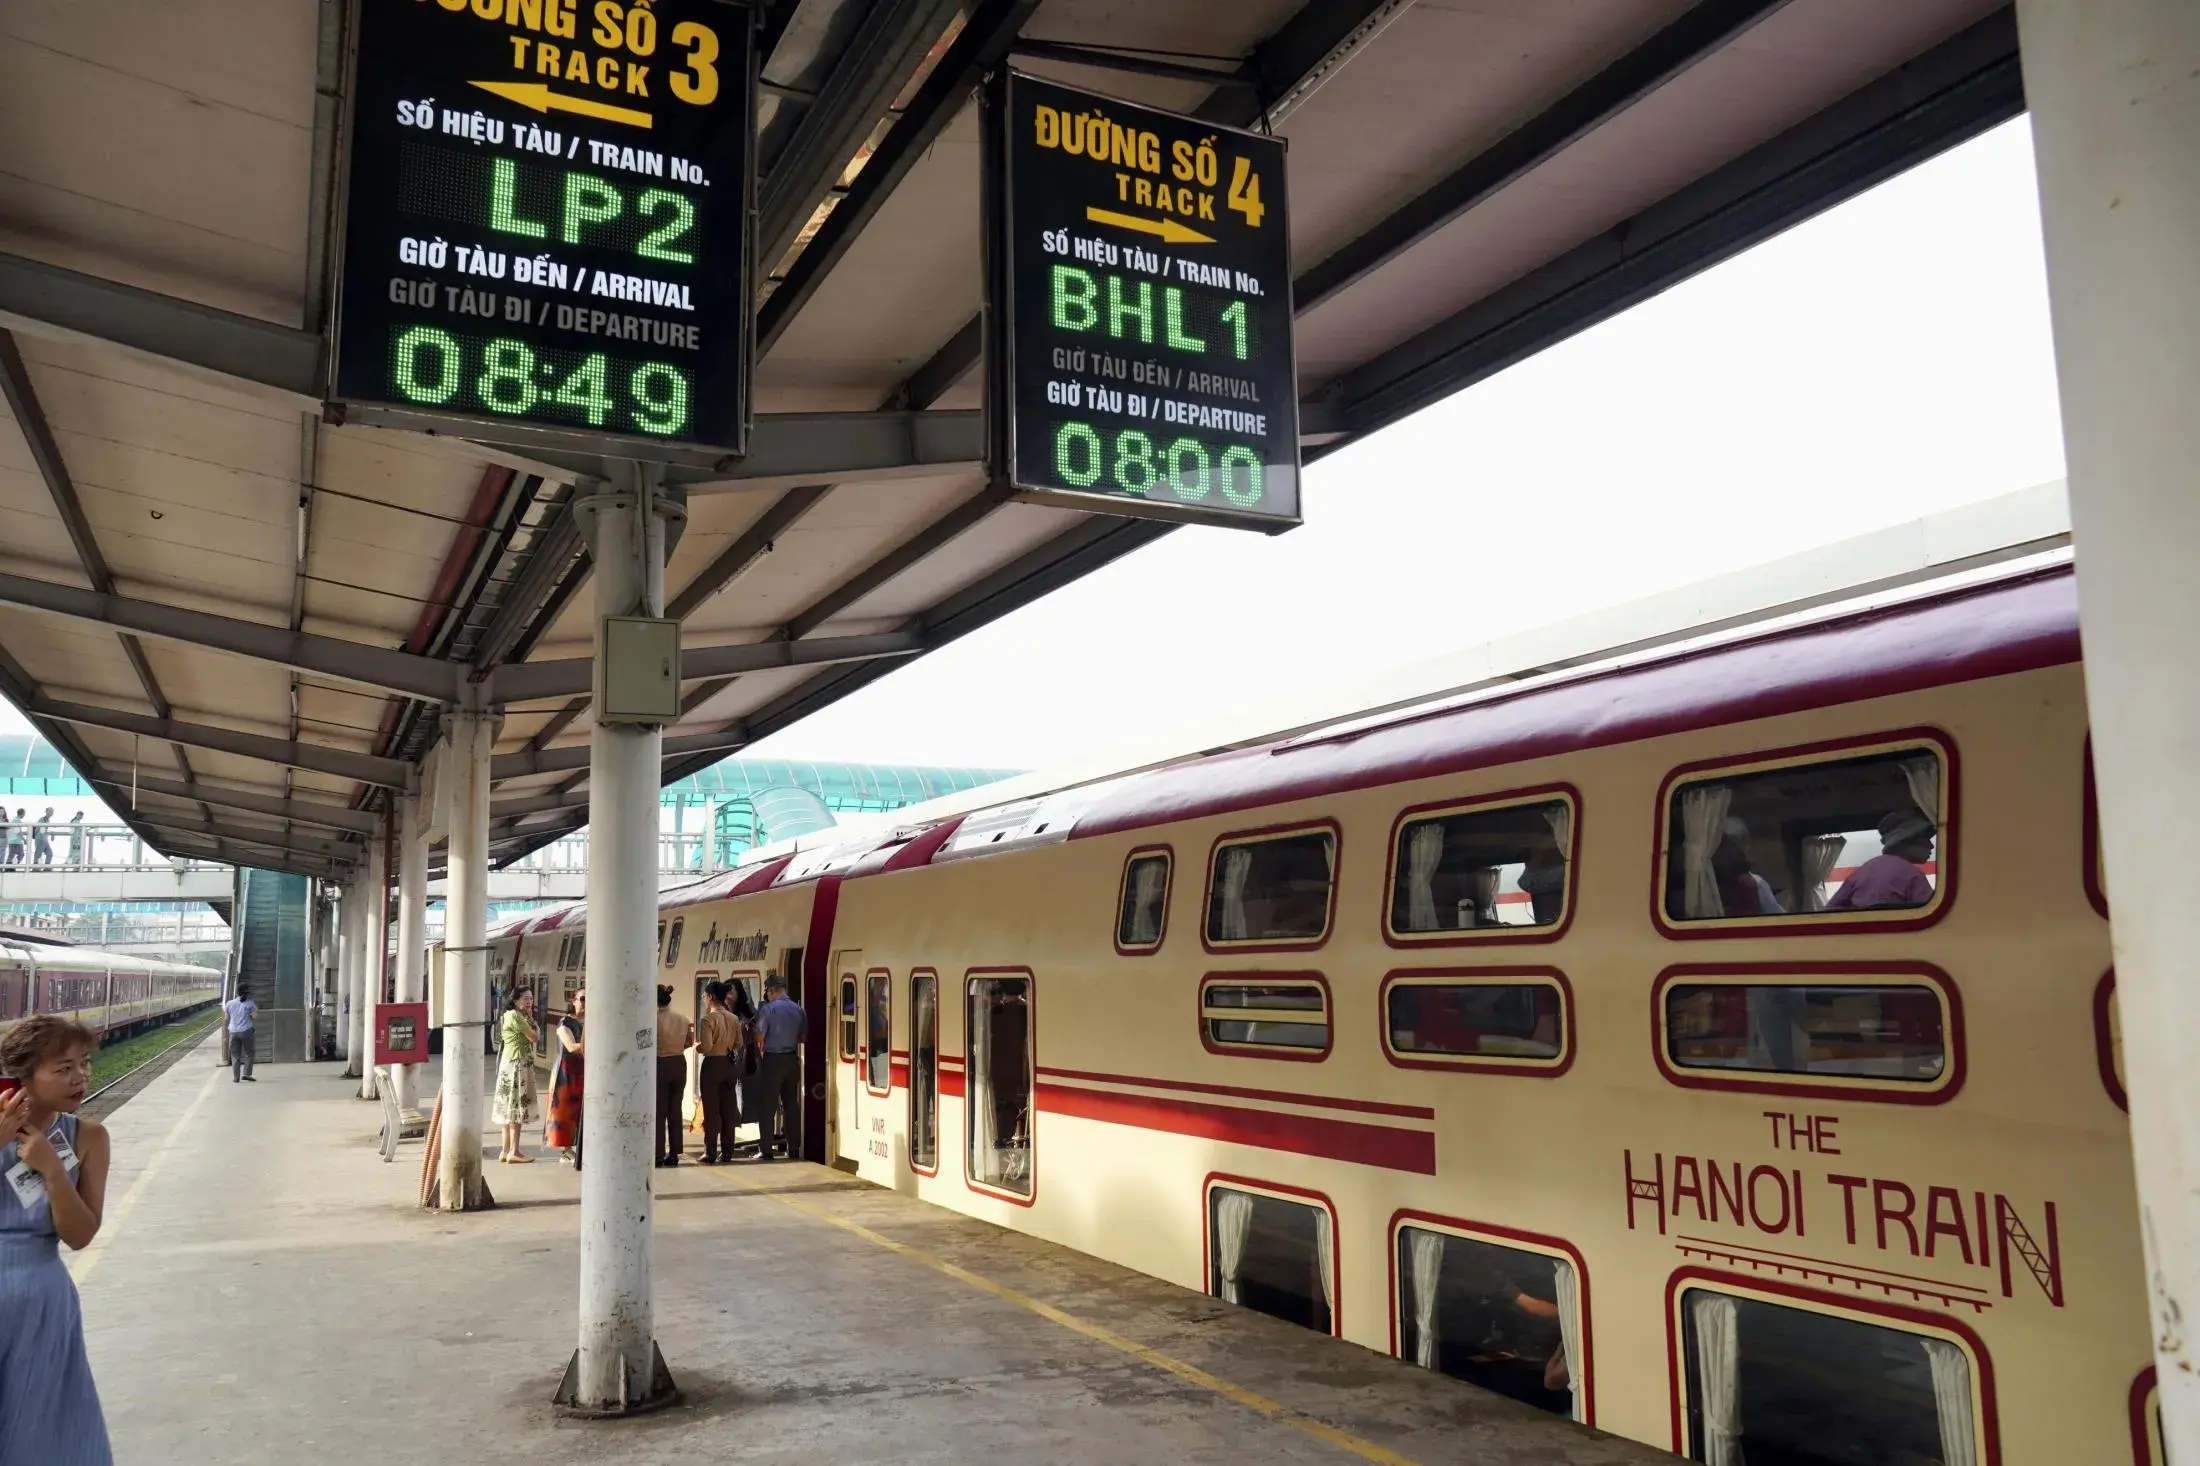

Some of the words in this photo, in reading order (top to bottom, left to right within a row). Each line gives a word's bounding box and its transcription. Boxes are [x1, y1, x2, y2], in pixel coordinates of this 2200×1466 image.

[509, 35, 650, 97] TRACK
[592, 0, 657, 57] SỐ
[669, 21, 720, 106] 3
[397, 98, 435, 130] SỐ
[443, 111, 504, 146] HIỆU
[512, 123, 561, 156] TÀU
[568, 137, 579, 159] /
[589, 141, 663, 177] TRAIN
[670, 163, 710, 186] No.
[1035, 105, 1160, 175] ĐƯỜNG
[1172, 134, 1218, 188] SỐ
[1227, 157, 1265, 227] 4
[1115, 172, 1216, 222] TRACK
[399, 236, 448, 269] GIỜ
[455, 246, 506, 279] TÀU
[514, 252, 568, 291] ĐẾN
[573, 268, 586, 292] /
[591, 271, 695, 311] ARRIVAL
[1042, 228, 1069, 255] SỐ
[1074, 237, 1118, 268] HIỆU
[1123, 245, 1158, 274] TÀU
[1163, 256, 1171, 277] /
[1177, 258, 1229, 290] TRAIN
[1235, 272, 1265, 297] No.
[389, 276, 437, 308] GIỜ
[445, 285, 497, 318] TÀU
[504, 299, 531, 323] ĐI
[538, 302, 550, 326] /
[557, 304, 700, 350] DEPARTURE
[396, 325, 688, 436] 08:49
[1047, 380, 1082, 406] GIỜ
[1086, 385, 1124, 415] TÀU
[1127, 392, 1147, 418] ĐI
[1151, 396, 1161, 420] /
[1164, 399, 1267, 437] DEPARTURE
[1053, 346, 1085, 373] GIỜ
[1092, 352, 1127, 380] TÀU
[1133, 359, 1170, 388] ĐẾN
[1175, 370, 1183, 390] /
[1188, 371, 1261, 402] ARRIVAL
[1055, 420, 1263, 508] 08:00
[1763, 1111, 1841, 1156] THE
[1624, 1148, 1805, 1237] HANOI
[1827, 1173, 2065, 1309] TRAIN
